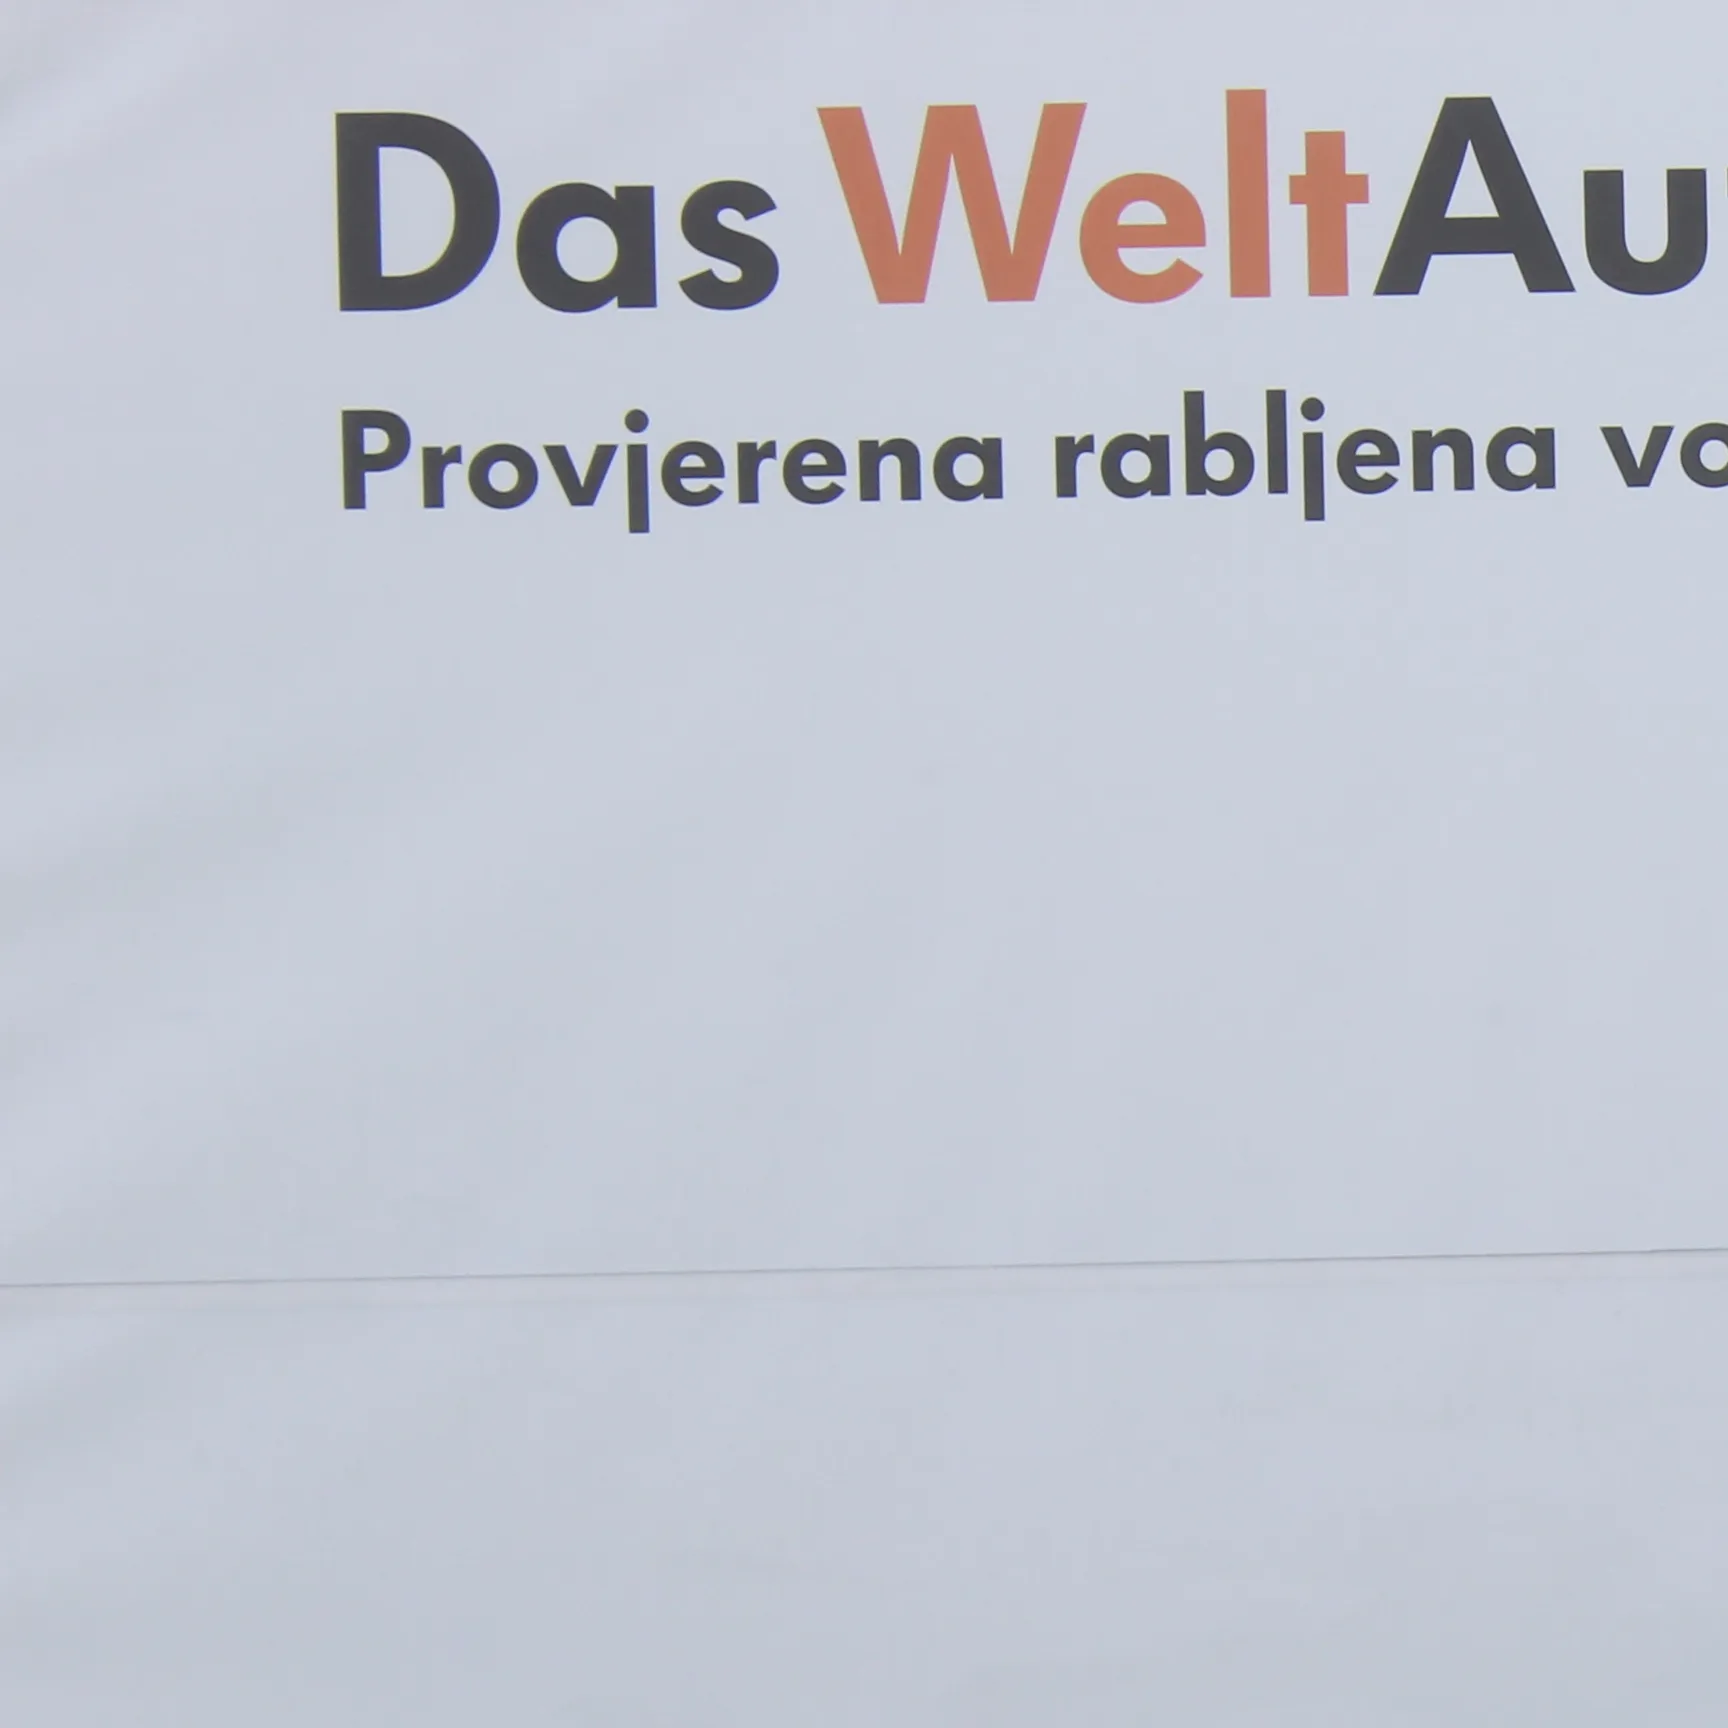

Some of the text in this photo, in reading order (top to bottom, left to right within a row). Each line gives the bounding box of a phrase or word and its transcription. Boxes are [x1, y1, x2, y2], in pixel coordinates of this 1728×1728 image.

[335, 111, 780, 314] Das
[341, 408, 1004, 534] Provjerena
[1054, 389, 1556, 522] rabljena
